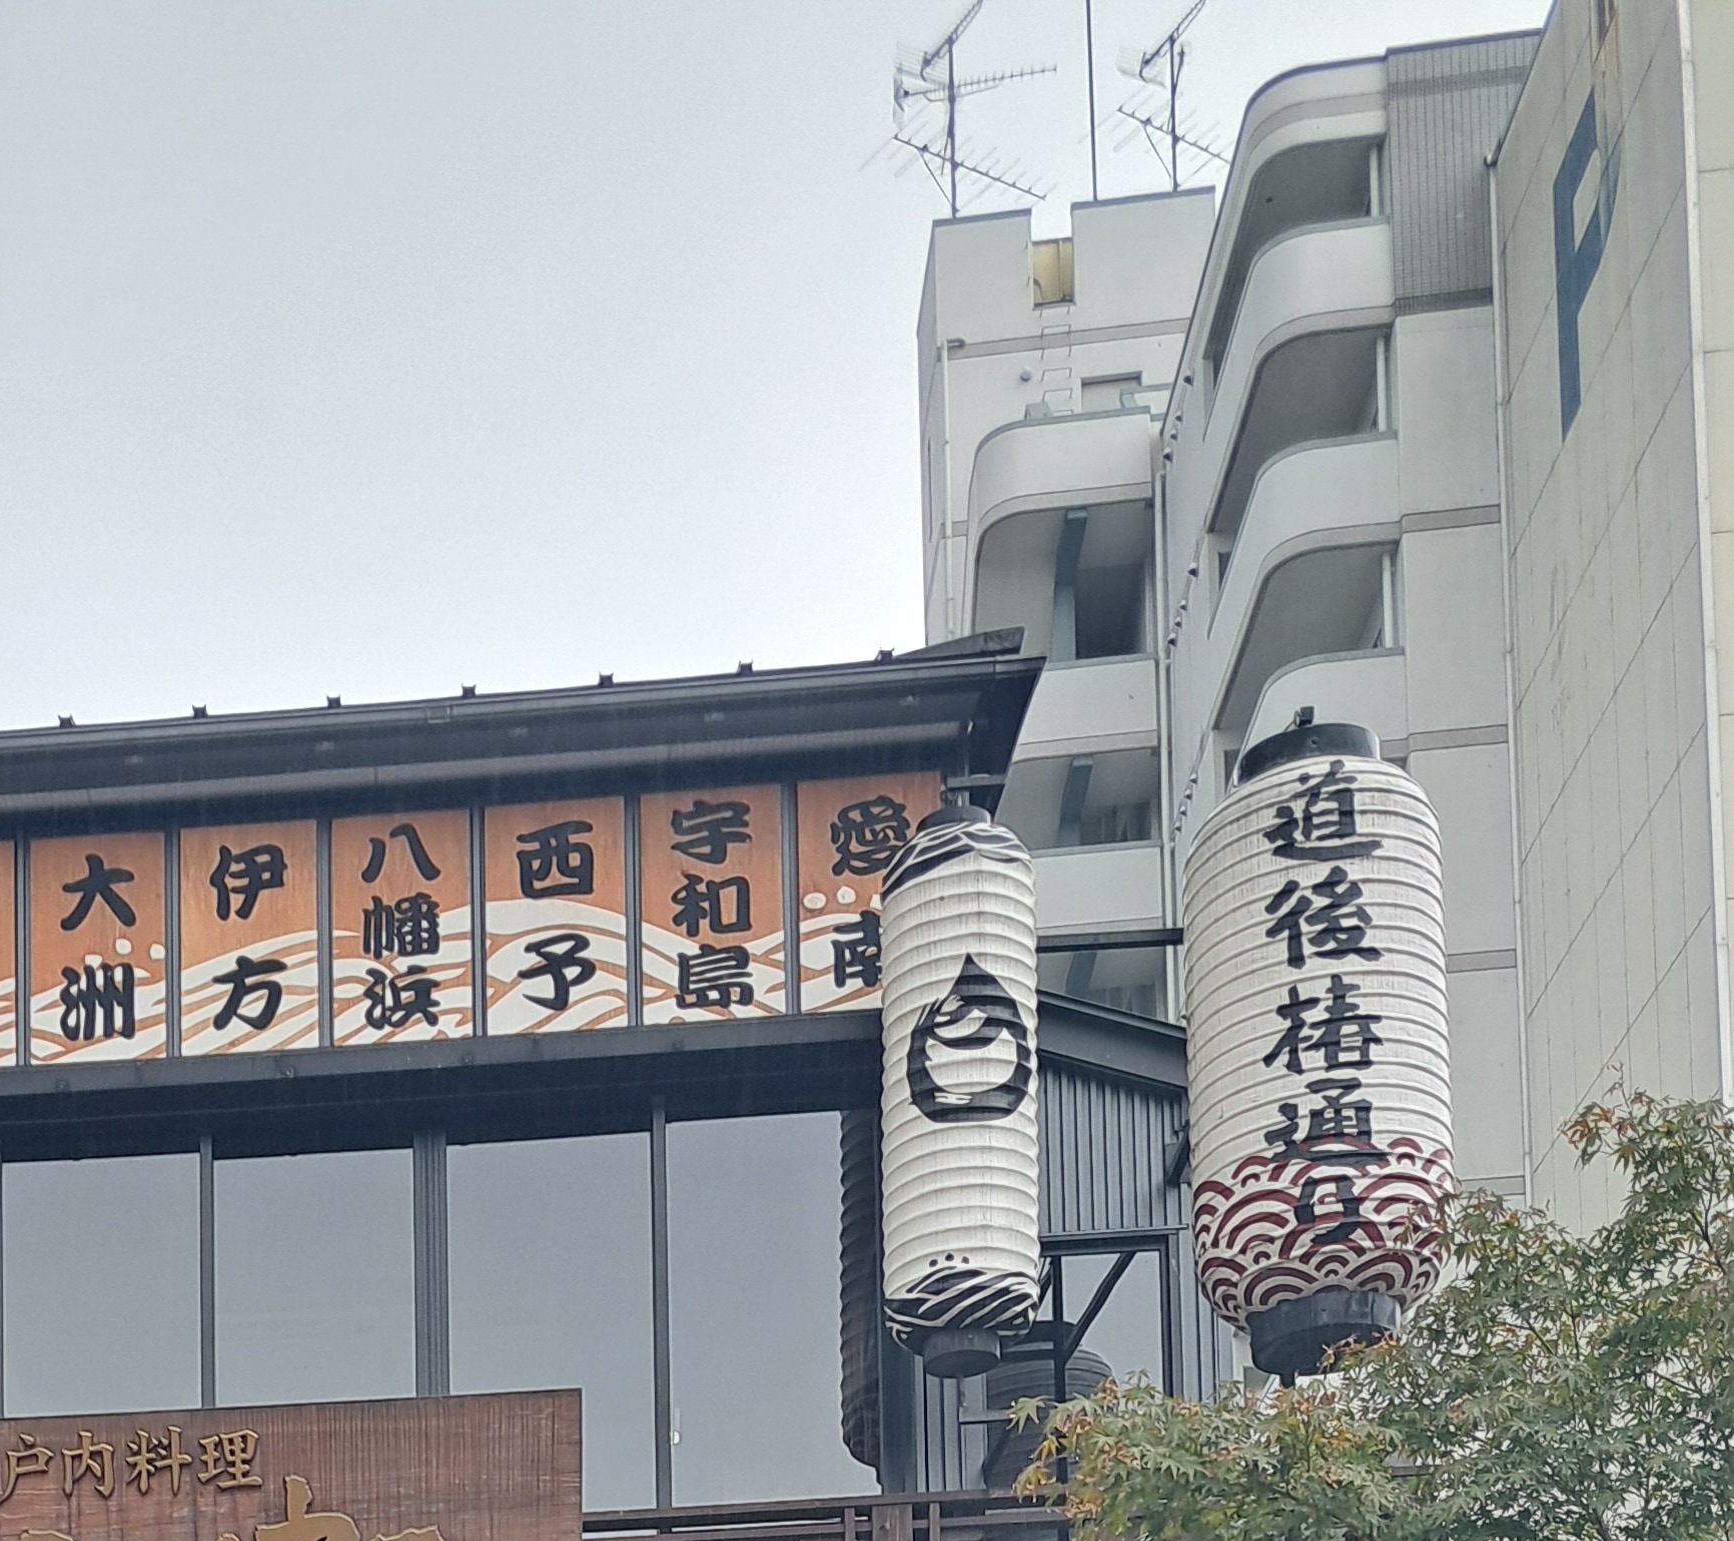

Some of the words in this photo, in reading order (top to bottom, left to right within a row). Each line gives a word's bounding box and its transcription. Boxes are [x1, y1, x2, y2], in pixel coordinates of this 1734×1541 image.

[60, 854, 137, 1042] 大洲
[209, 844, 288, 1030] 伊方
[361, 822, 441, 1030] 八幡浜
[516, 819, 596, 1011] 西予
[670, 799, 753, 1009] 宇和島
